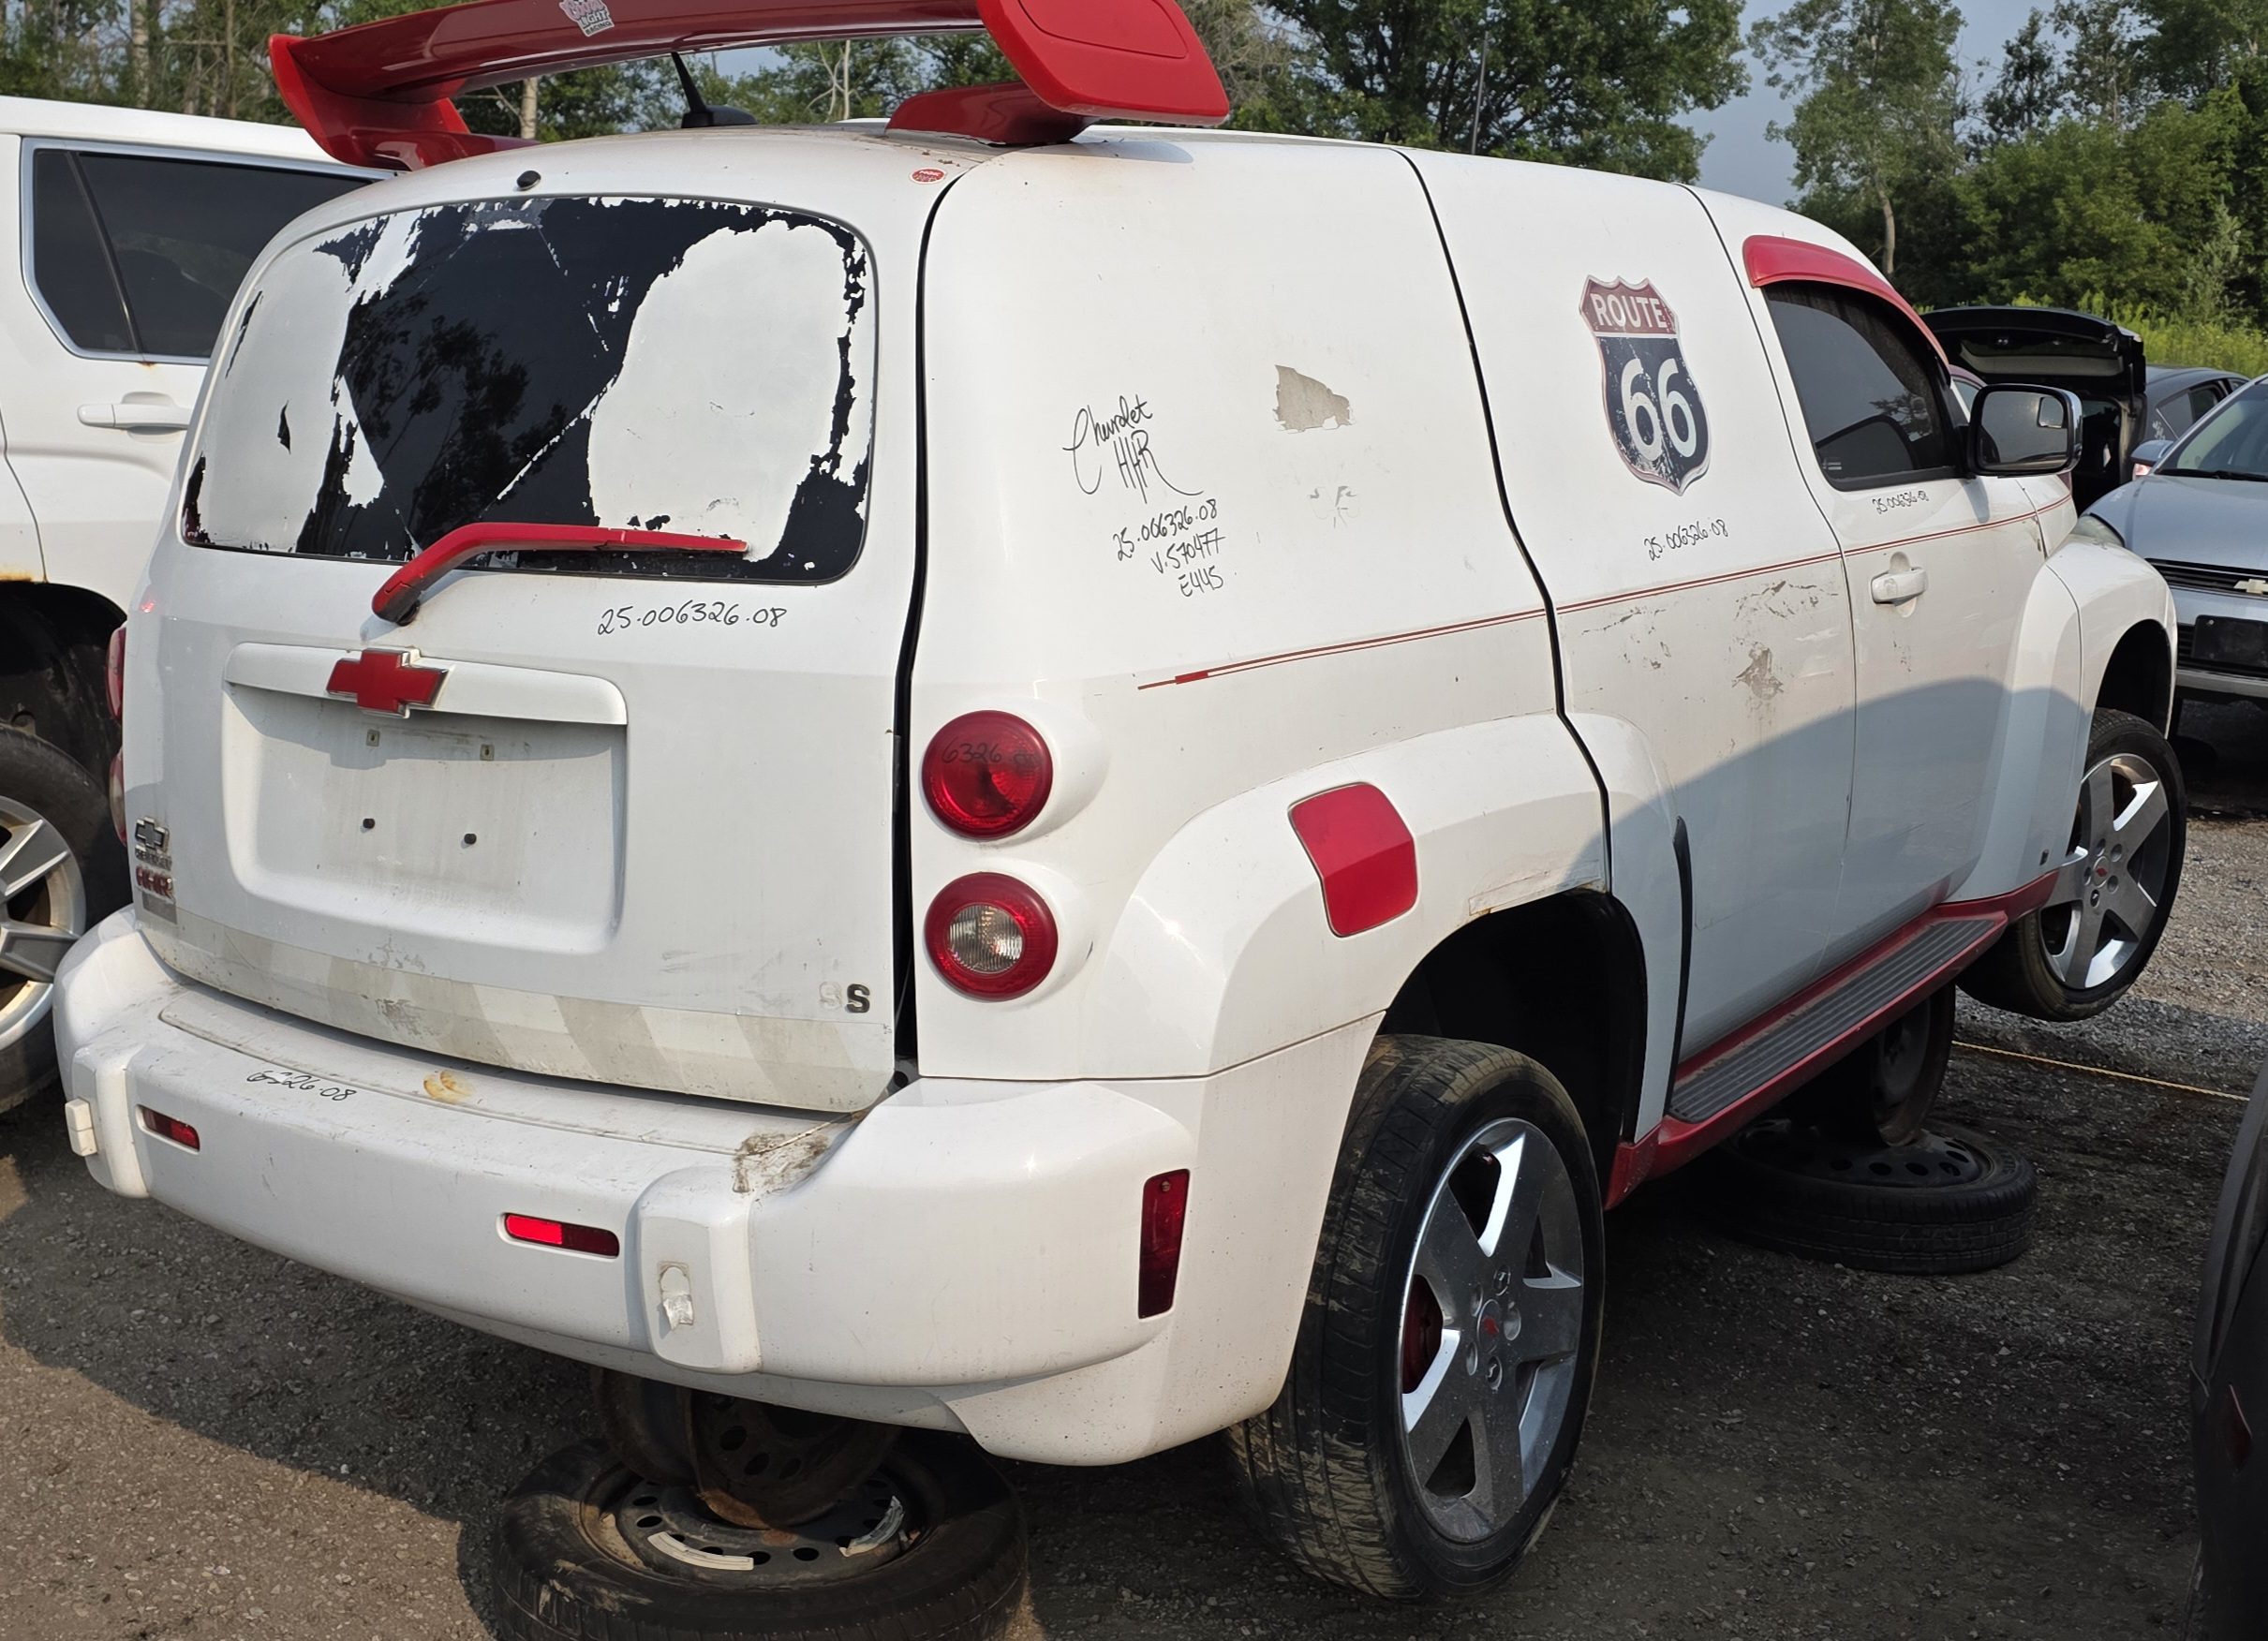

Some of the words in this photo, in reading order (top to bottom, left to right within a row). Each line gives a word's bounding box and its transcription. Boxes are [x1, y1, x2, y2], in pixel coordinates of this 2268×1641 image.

[579, 9, 608, 27] LIGHT
[1590, 292, 1668, 330] ROUTE
[1621, 358, 1697, 461] 66
[1112, 498, 1218, 561] 25.006326.08
[597, 599, 788, 635] 25.006326.08
